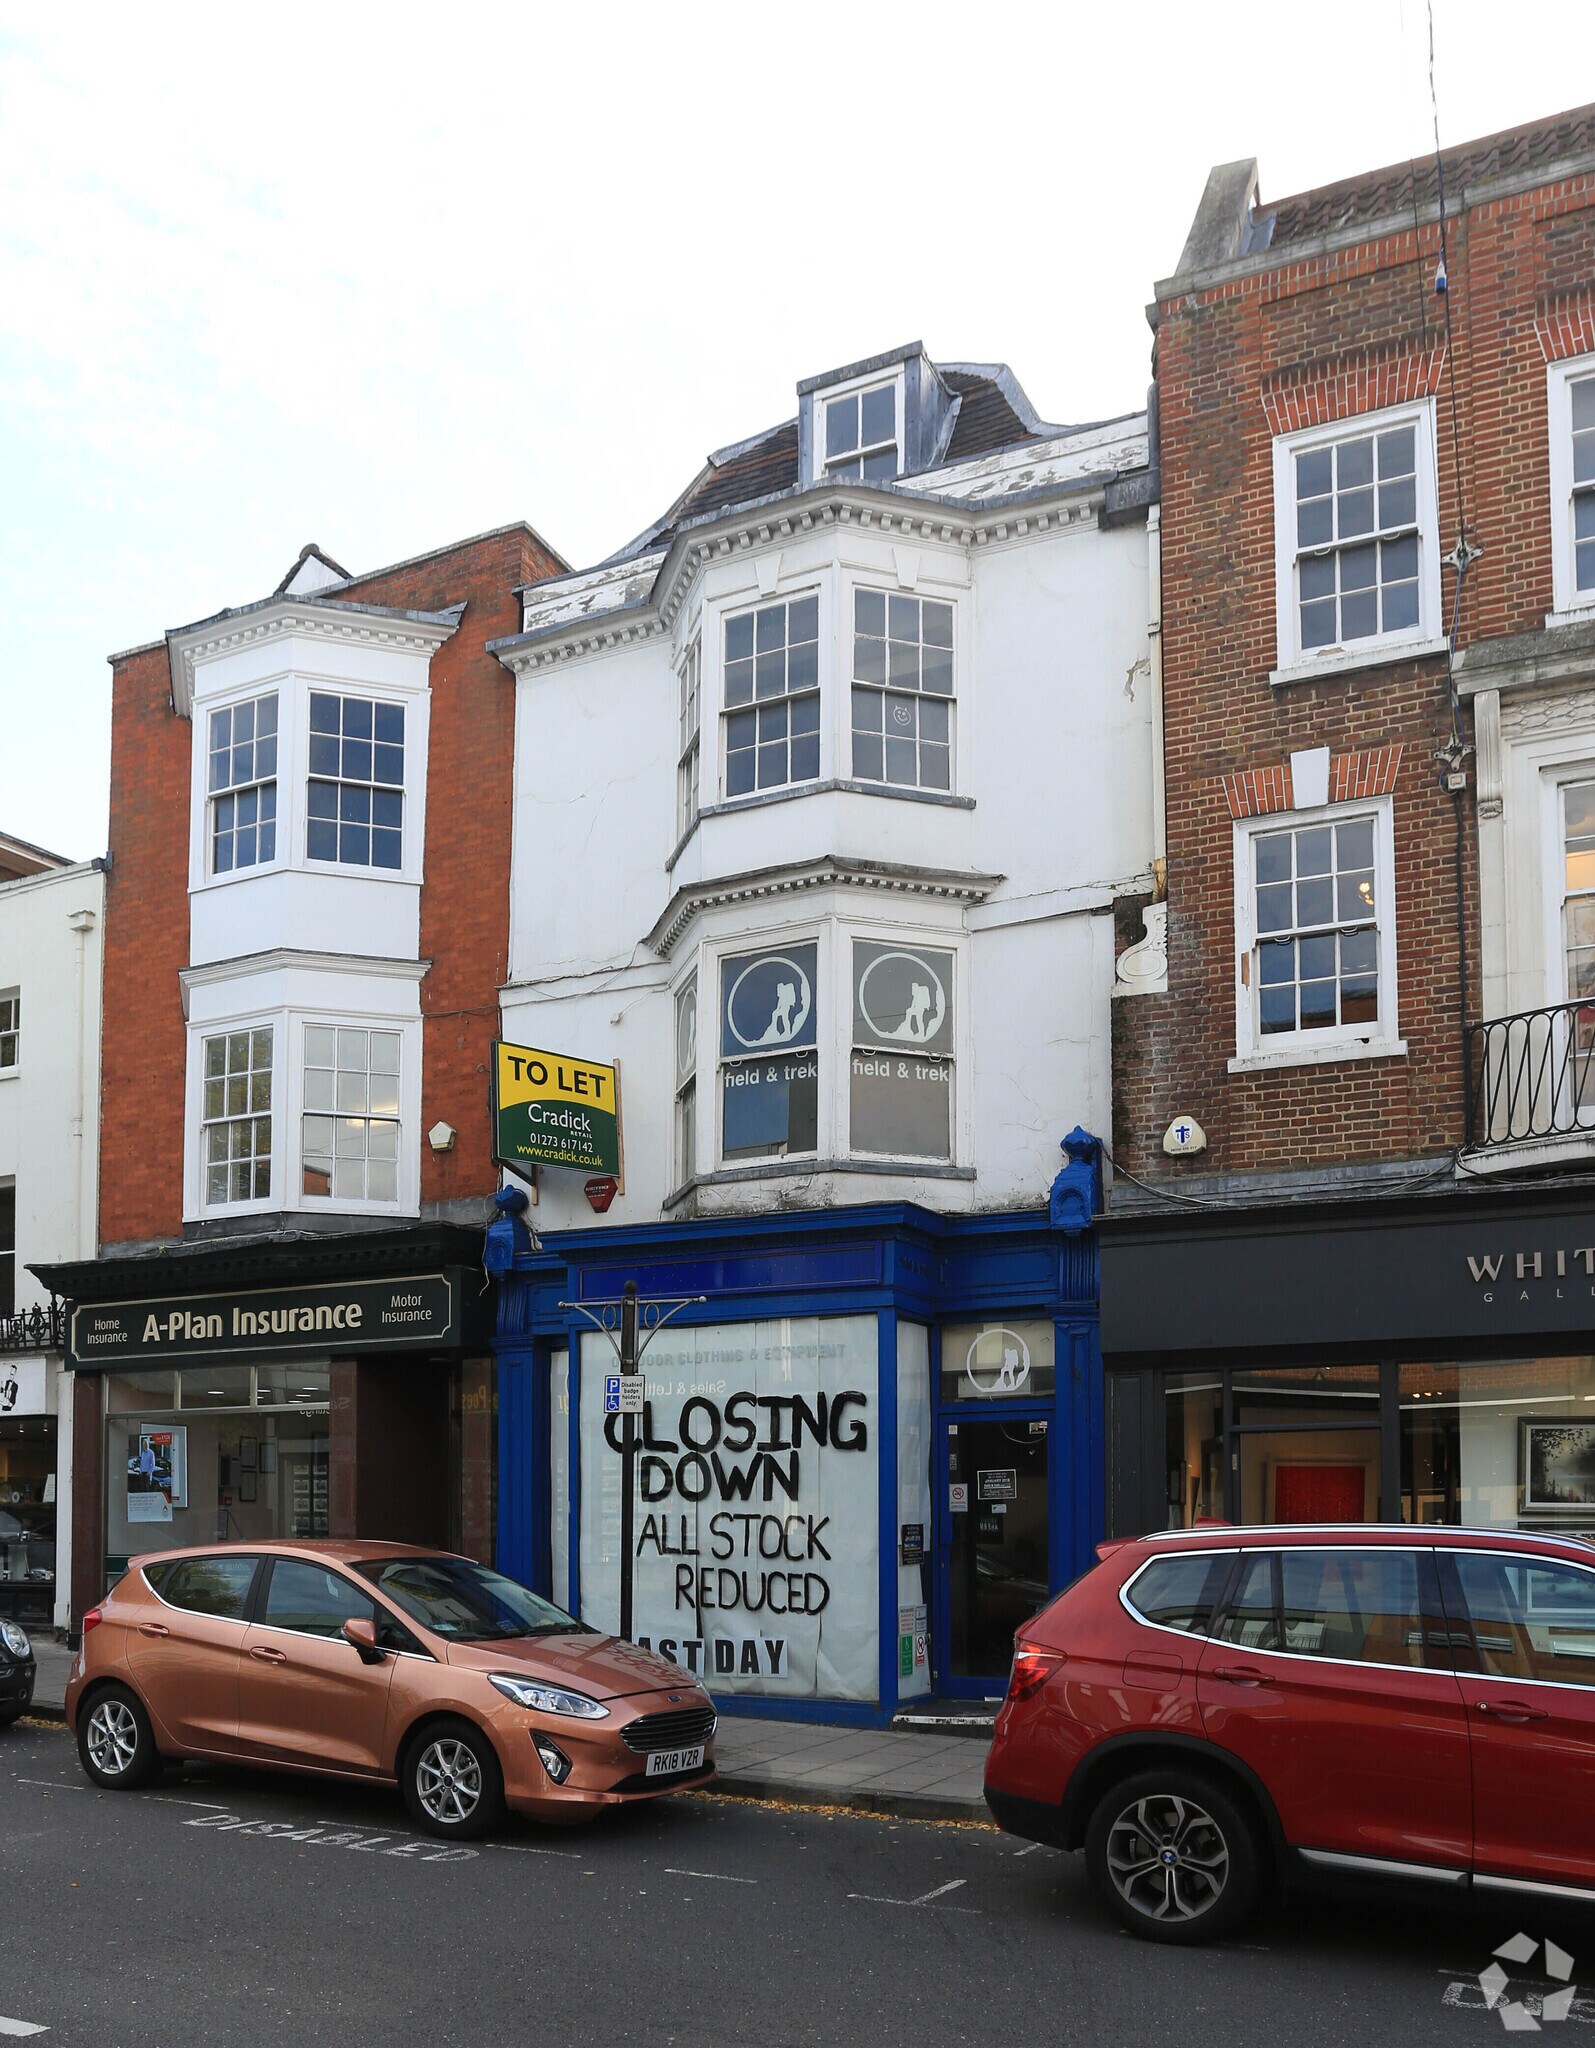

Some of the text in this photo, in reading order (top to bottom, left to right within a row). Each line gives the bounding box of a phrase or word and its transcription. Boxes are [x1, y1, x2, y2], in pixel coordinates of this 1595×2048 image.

[507, 1055, 607, 1098] TO LET
[724, 1062, 818, 1088] field & trek
[852, 1059, 950, 1082] field & trek
[528, 1103, 592, 1132] Cradick
[530, 1132, 594, 1153] 01273 617142
[570, 1130, 593, 1139] RETAIL
[516, 1145, 604, 1167] www.cradick.co.uk
[1466, 1247, 1595, 1282] WHIT
[391, 1294, 422, 1308] Motor
[94, 1318, 120, 1332] Home
[142, 1303, 363, 1343] A-Plan Insurance
[381, 1308, 432, 1324] Insurance
[87, 1331, 128, 1345] Insurance
[611, 1353, 674, 1368] ODOOR
[678, 1348, 744, 1366] CLOTHING
[749, 1348, 759, 1361] &
[609, 1379, 619, 1392] P
[603, 1391, 867, 1454] CLOSING
[640, 1450, 800, 1502] DOWN
[636, 1512, 832, 1561] ALL STOCK
[675, 1563, 830, 1616] REDUCED
[714, 1639, 785, 1675] DAY
[653, 1749, 699, 1772] RK18 VZR
[181, 1814, 480, 1862] DISABLED
